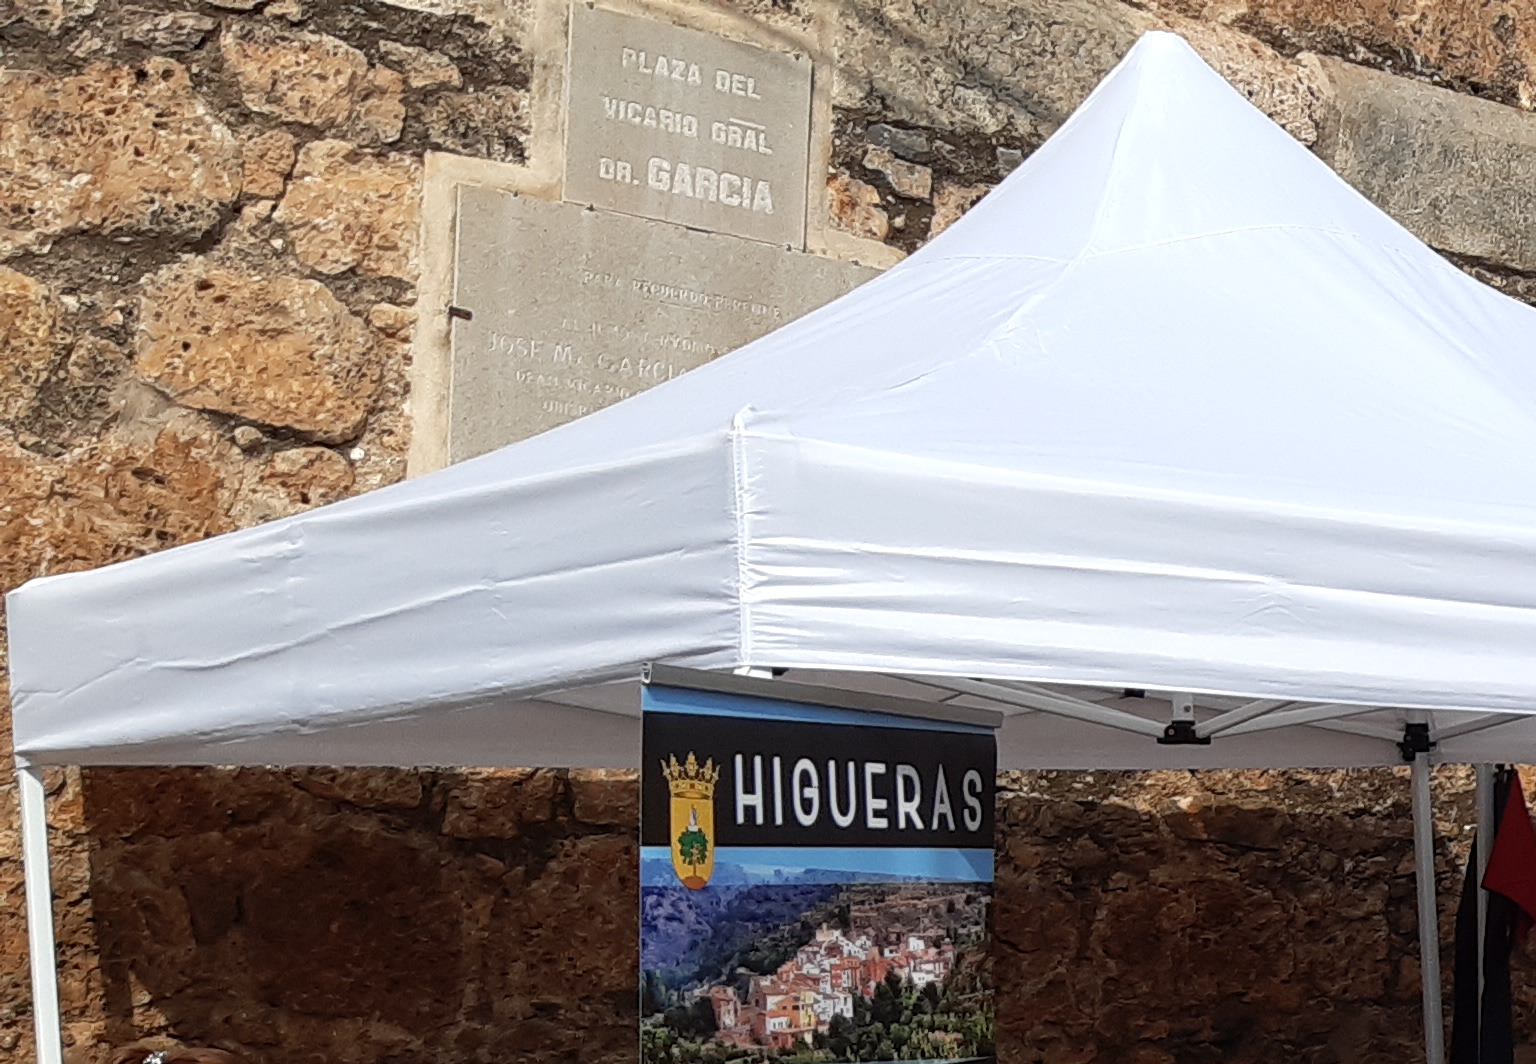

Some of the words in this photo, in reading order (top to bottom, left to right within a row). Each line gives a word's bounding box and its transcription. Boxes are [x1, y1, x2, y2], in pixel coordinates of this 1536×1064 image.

[622, 47, 702, 85] PLAZA
[714, 69, 761, 100] DEL
[603, 96, 698, 138] VICARIO
[711, 119, 773, 155] GRAL
[599, 157, 640, 186] DR.
[647, 157, 774, 215] GARCIA
[734, 753, 984, 832] HIGUERAS
